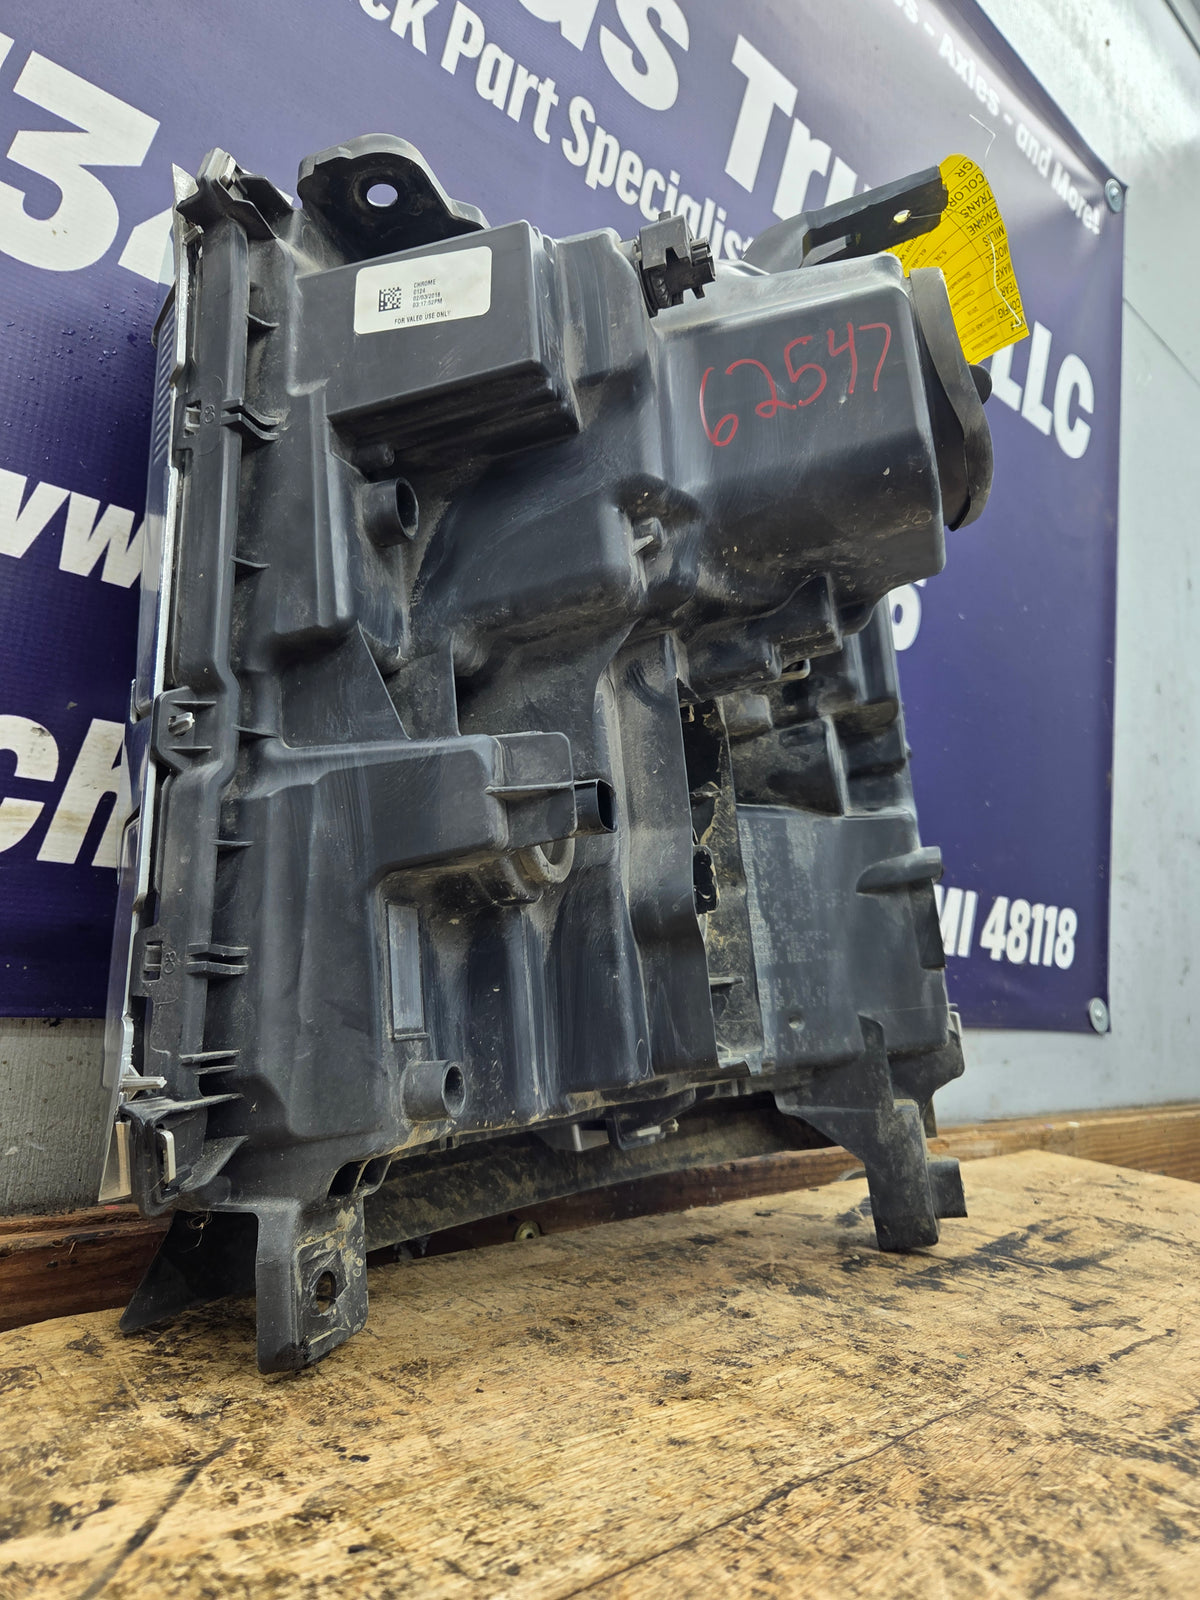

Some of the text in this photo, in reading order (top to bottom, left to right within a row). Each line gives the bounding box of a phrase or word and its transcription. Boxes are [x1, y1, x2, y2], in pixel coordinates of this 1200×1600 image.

[441, 0, 559, 143] Part
[938, 33, 1000, 116] Axles
[1015, 123, 1052, 178] and
[1051, 163, 1101, 234] More!
[955, 161, 973, 178] GR
[948, 173, 985, 208] COLOR
[960, 190, 994, 218] TRANS
[967, 207, 999, 236] ENGINE
[413, 279, 436, 288] CHROME
[1001, 282, 1018, 298] YEAR
[407, 313, 423, 323] VALEO
[425, 312, 435, 320] USE
[437, 310, 452, 318] ONLY
[699, 322, 891, 447] 62547
[989, 320, 1095, 459] LLC
[980, 896, 1077, 970] 48118
